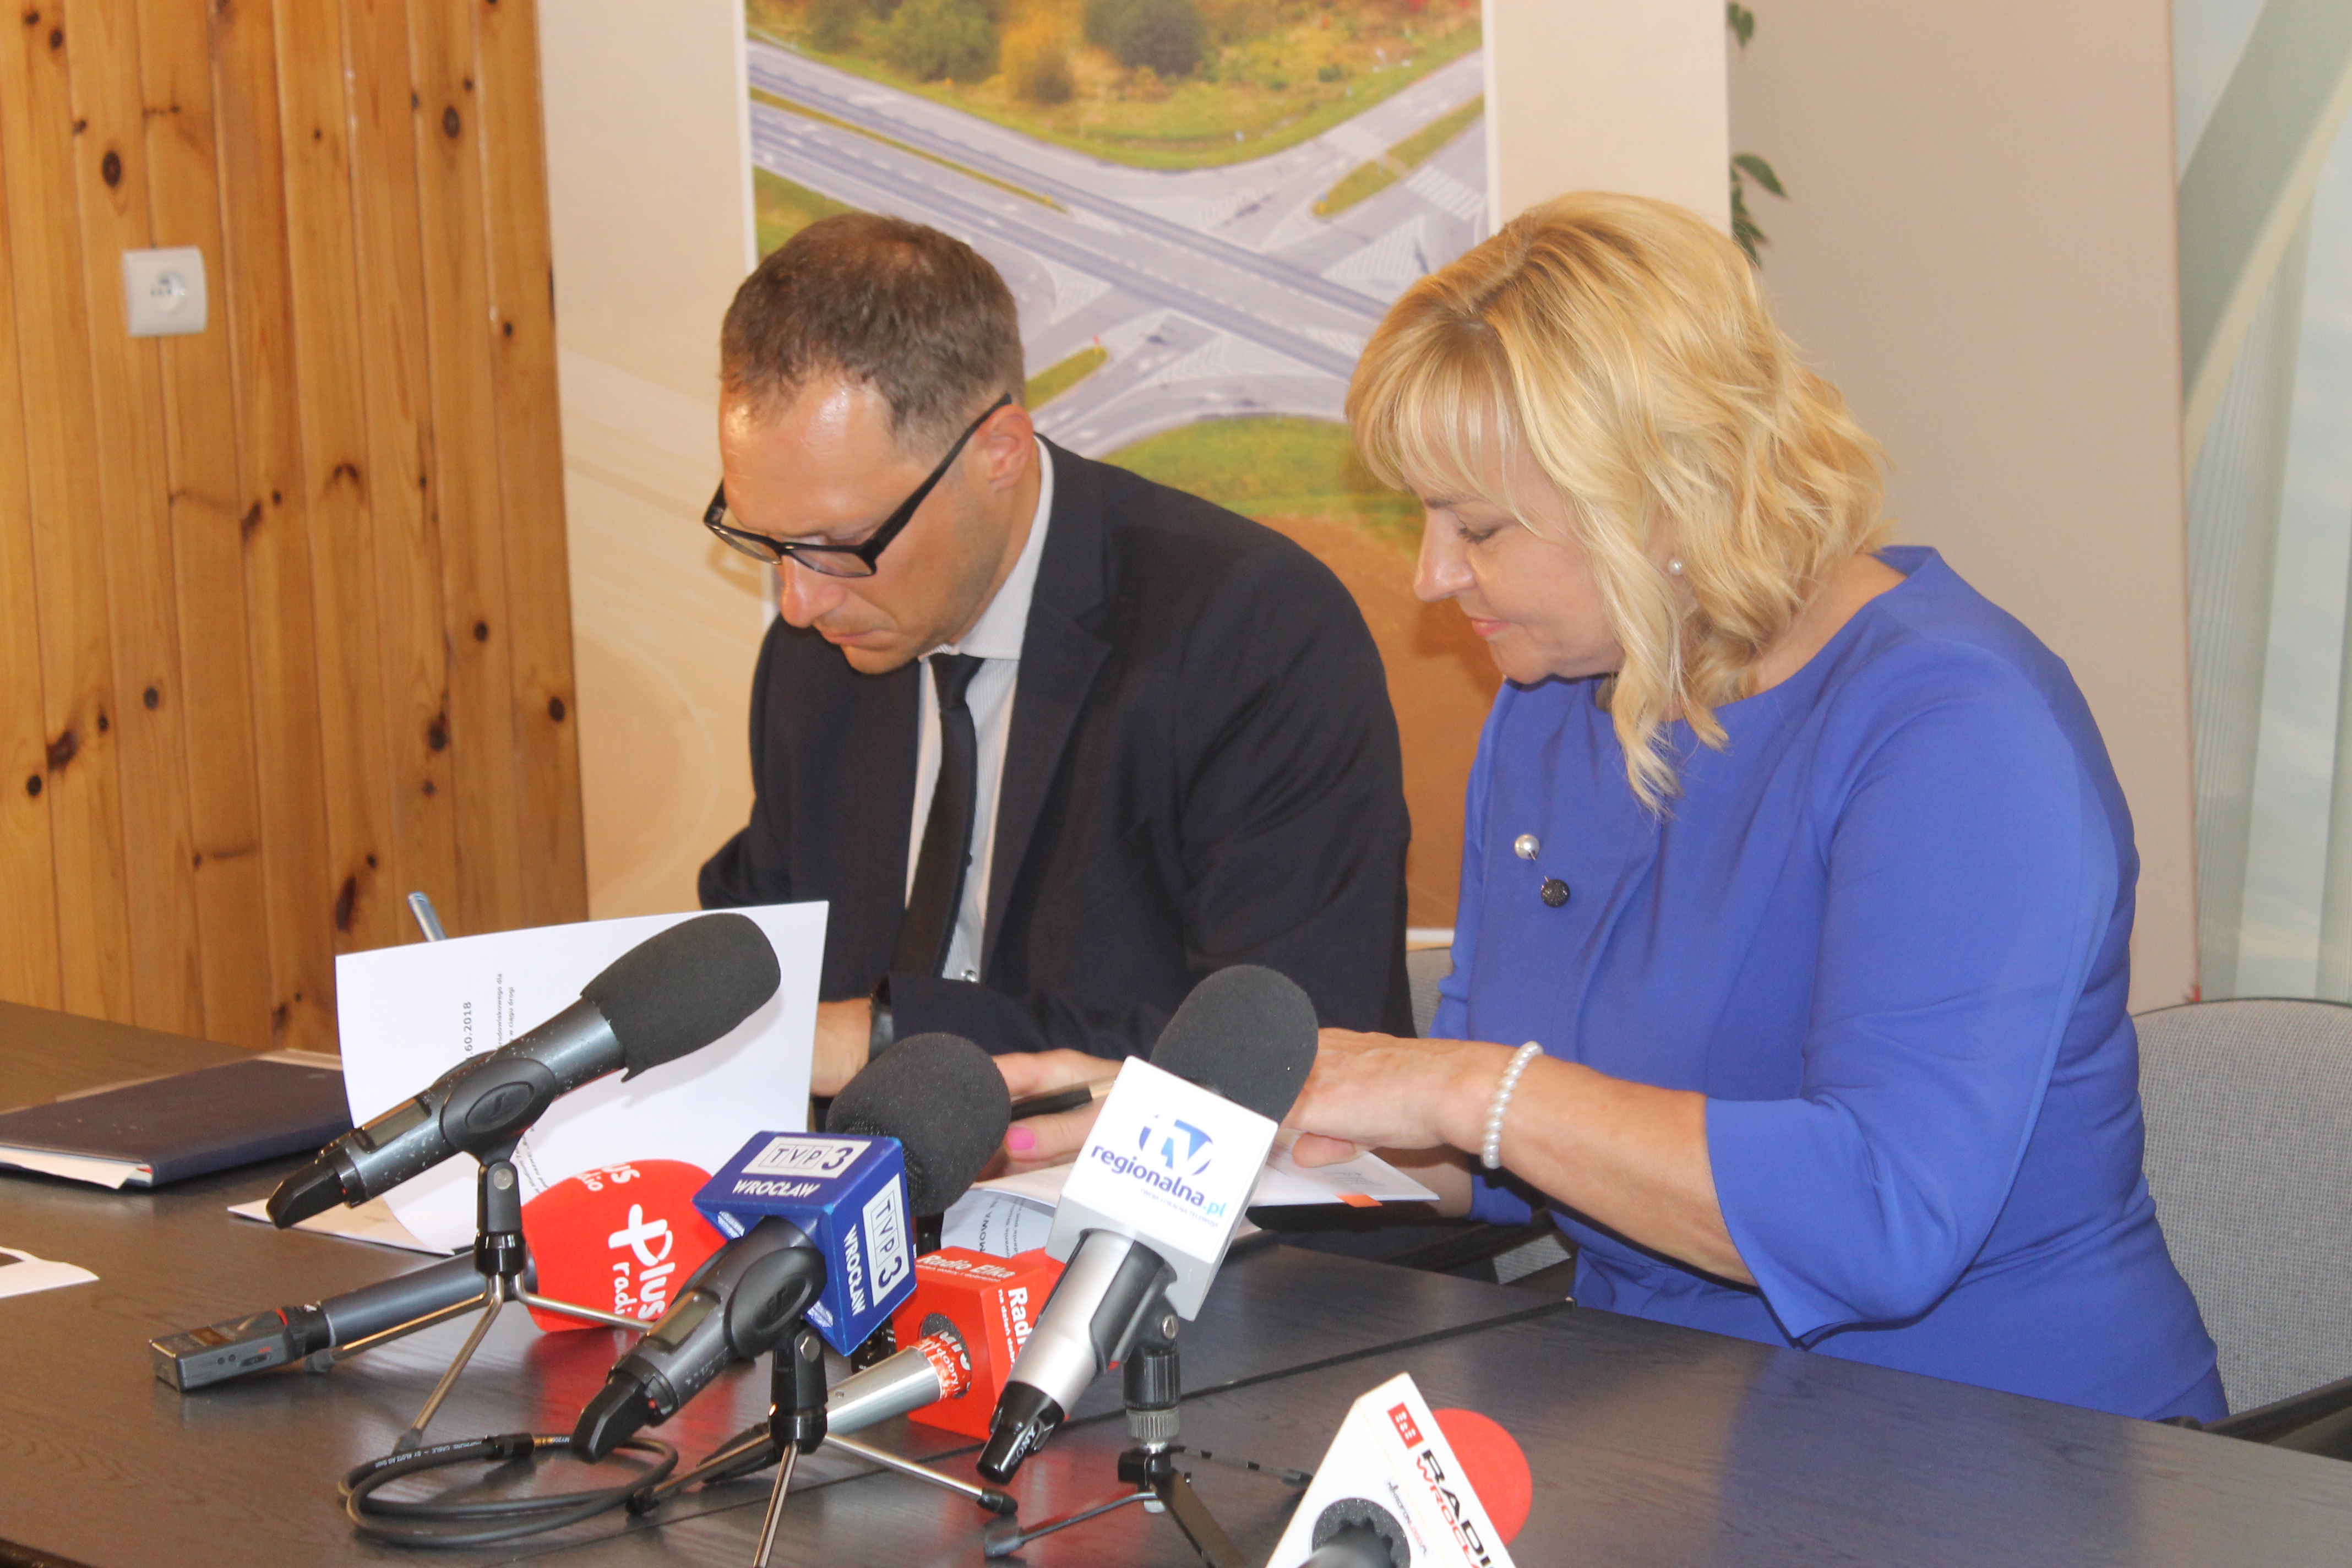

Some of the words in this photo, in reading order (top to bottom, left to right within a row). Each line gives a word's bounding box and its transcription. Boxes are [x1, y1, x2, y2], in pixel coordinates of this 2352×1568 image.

[732, 1180, 821, 1198] WROCŁAW
[979, 1211, 993, 1252] MOWA
[612, 1261, 638, 1315] radi
[843, 1223, 867, 1317] WROCŁAW
[916, 1255, 972, 1271] Radio
[970, 1264, 1016, 1279] Elka
[998, 1288, 1004, 1304] na
[1001, 1305, 1011, 1336] dzień
[1008, 1287, 1033, 1352] Radi
[1422, 1449, 1491, 1567] RADI
